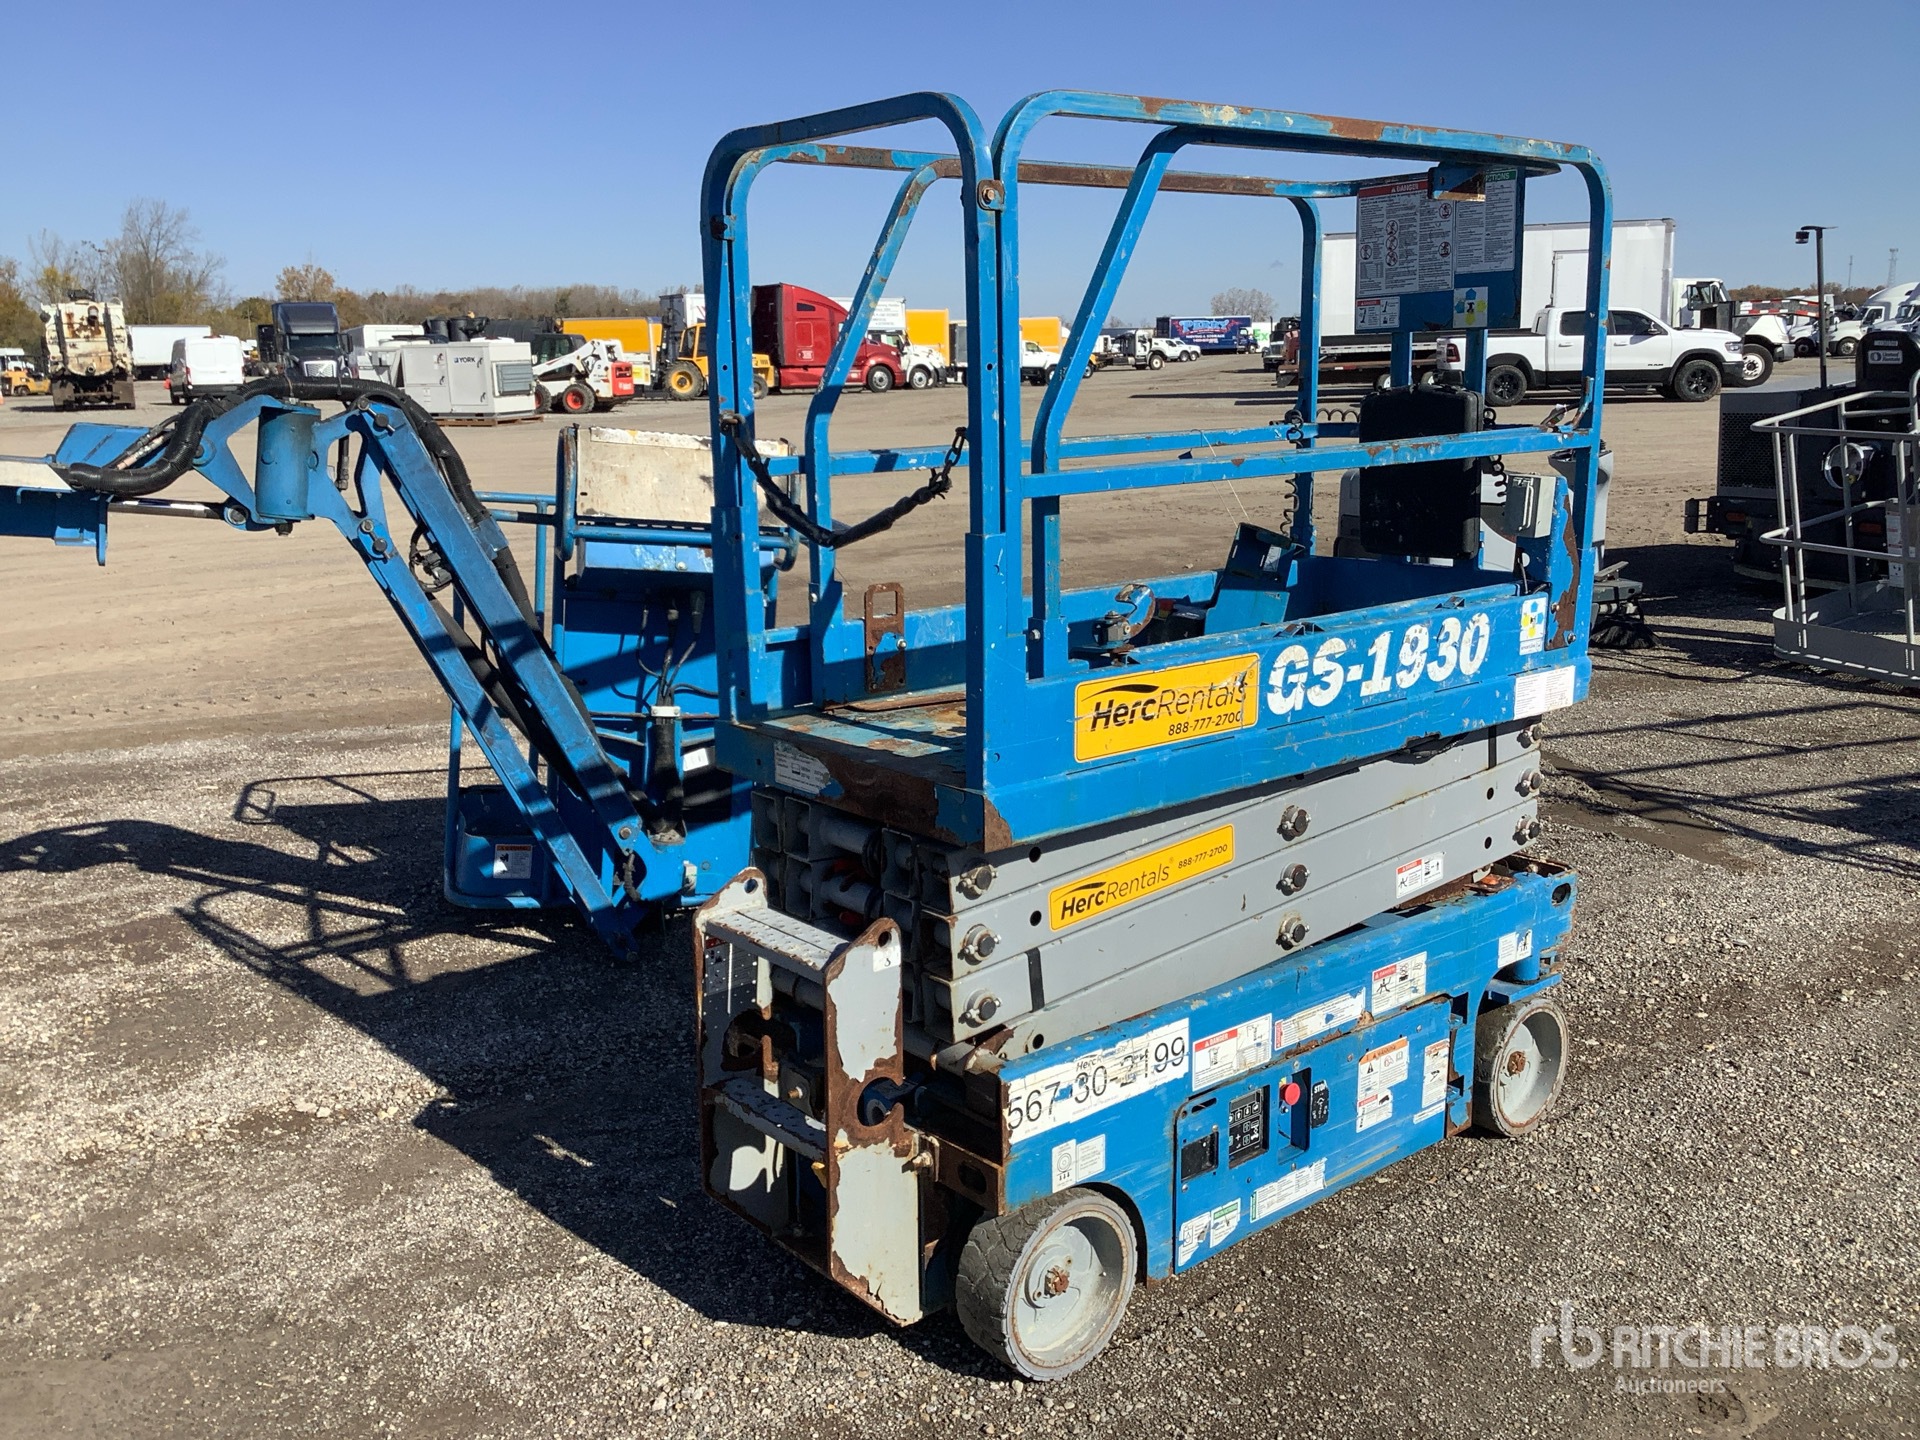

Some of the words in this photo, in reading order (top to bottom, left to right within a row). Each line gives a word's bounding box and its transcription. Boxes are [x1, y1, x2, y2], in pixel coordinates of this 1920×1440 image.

[1396, 183, 1419, 193] DANGER
[1267, 613, 1490, 715] GS-1930
[1090, 672, 1248, 732] HercRentals
[1168, 710, 1242, 736] 888-777-2700
[1060, 863, 1169, 920] HercRentals
[1177, 843, 1228, 869] 888-777-2700
